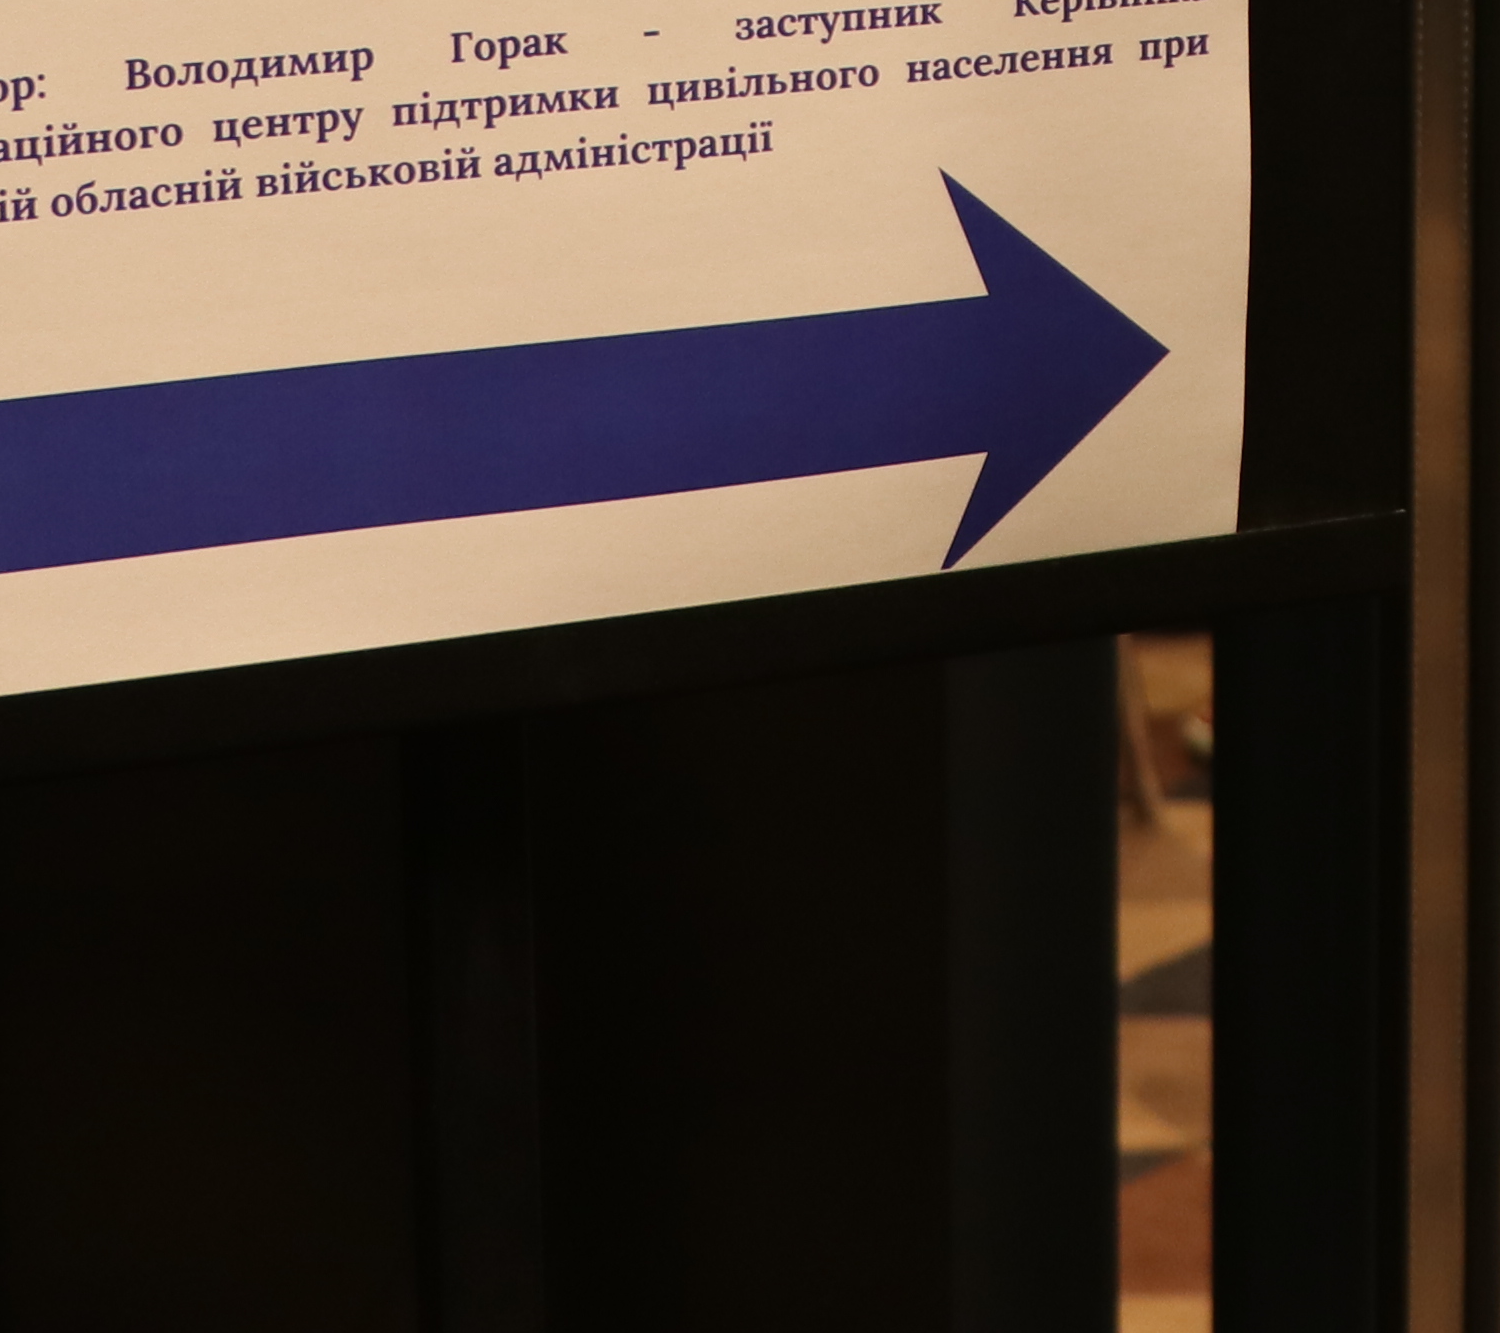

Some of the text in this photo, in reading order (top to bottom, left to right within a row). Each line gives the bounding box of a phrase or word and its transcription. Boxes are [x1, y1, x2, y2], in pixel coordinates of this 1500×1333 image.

[122, 46, 376, 92] Володимир
[448, 30, 571, 72] Горак
[733, 1, 945, 46] заступник
[210, 106, 366, 150] центру
[390, 84, 622, 132] підтримки
[645, 63, 881, 113] цивільного
[904, 42, 1115, 85] населення
[1137, 32, 1211, 71] при
[48, 166, 245, 219] обласній
[253, 144, 484, 199] військовій
[492, 119, 775, 184] адміністрації
